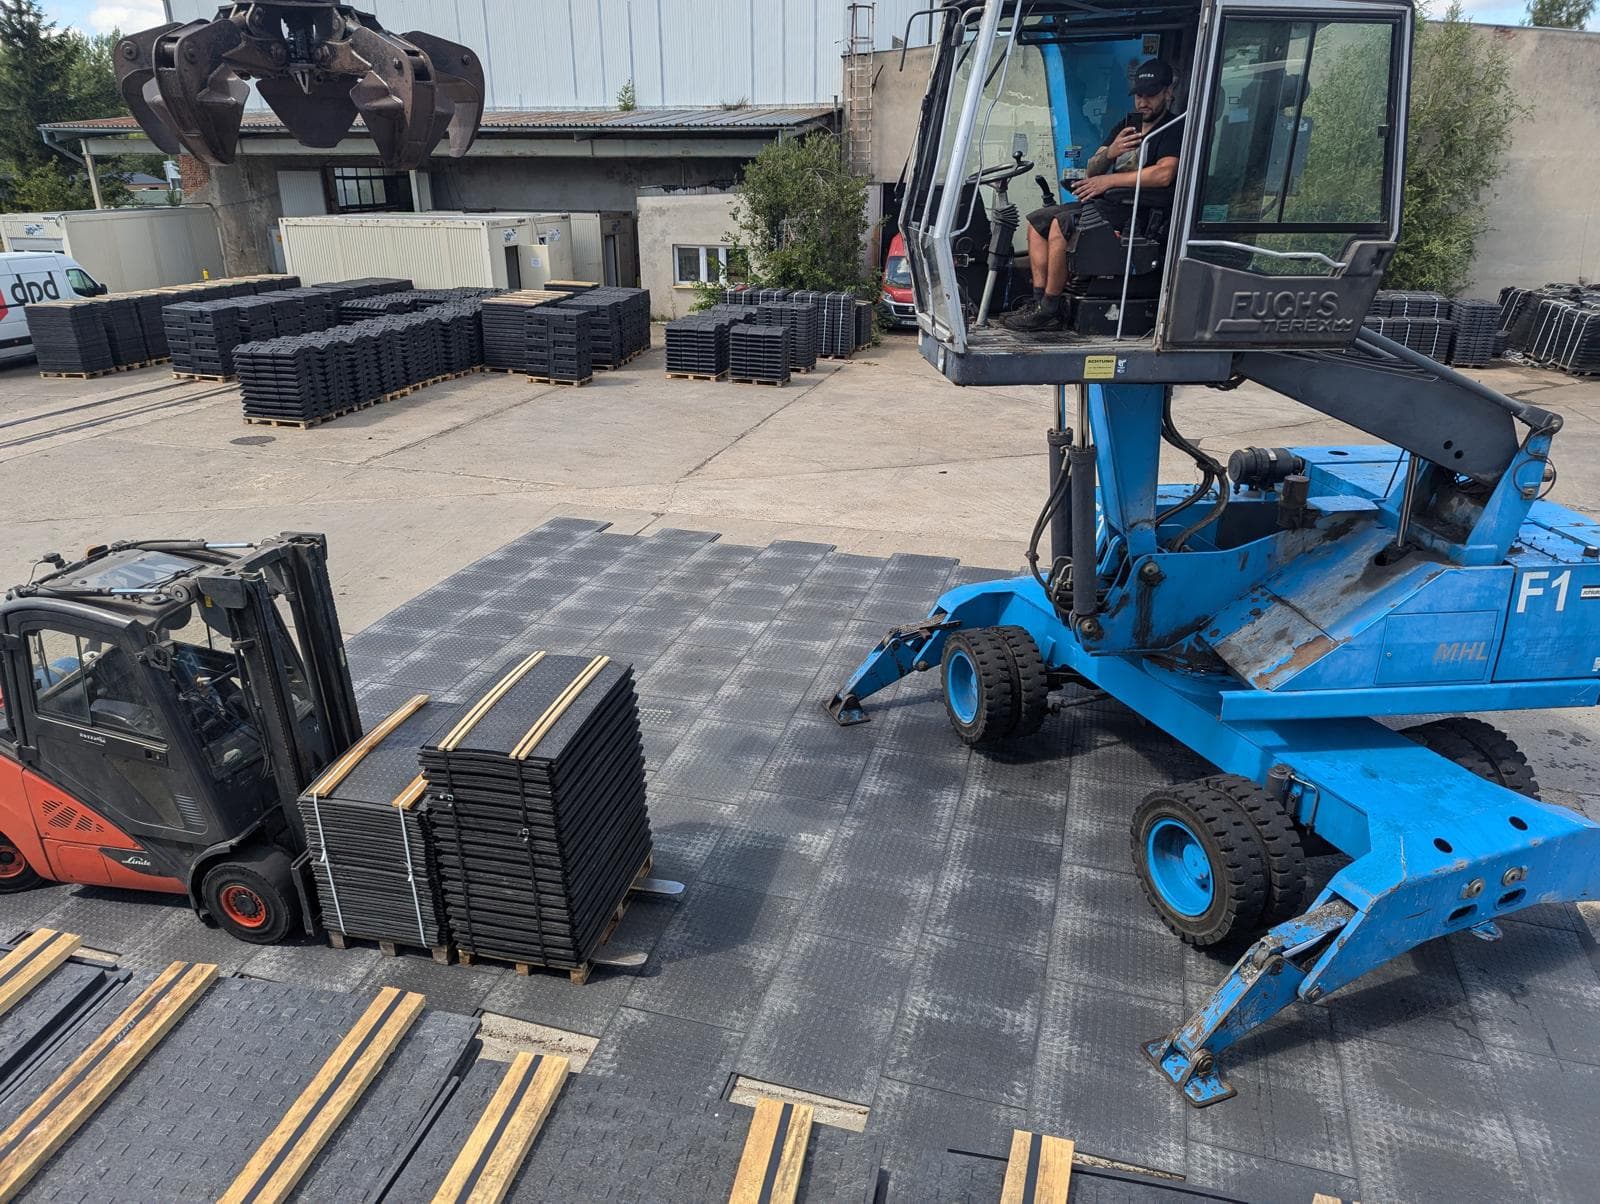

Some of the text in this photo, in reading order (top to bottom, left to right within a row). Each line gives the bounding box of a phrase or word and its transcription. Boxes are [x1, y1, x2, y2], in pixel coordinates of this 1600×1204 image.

[11, 271, 60, 304] dpd
[1230, 291, 1339, 317] FUCHS
[1262, 318, 1333, 332] TEREX
[1516, 570, 1571, 613] F1
[1432, 641, 1488, 664] MHL
